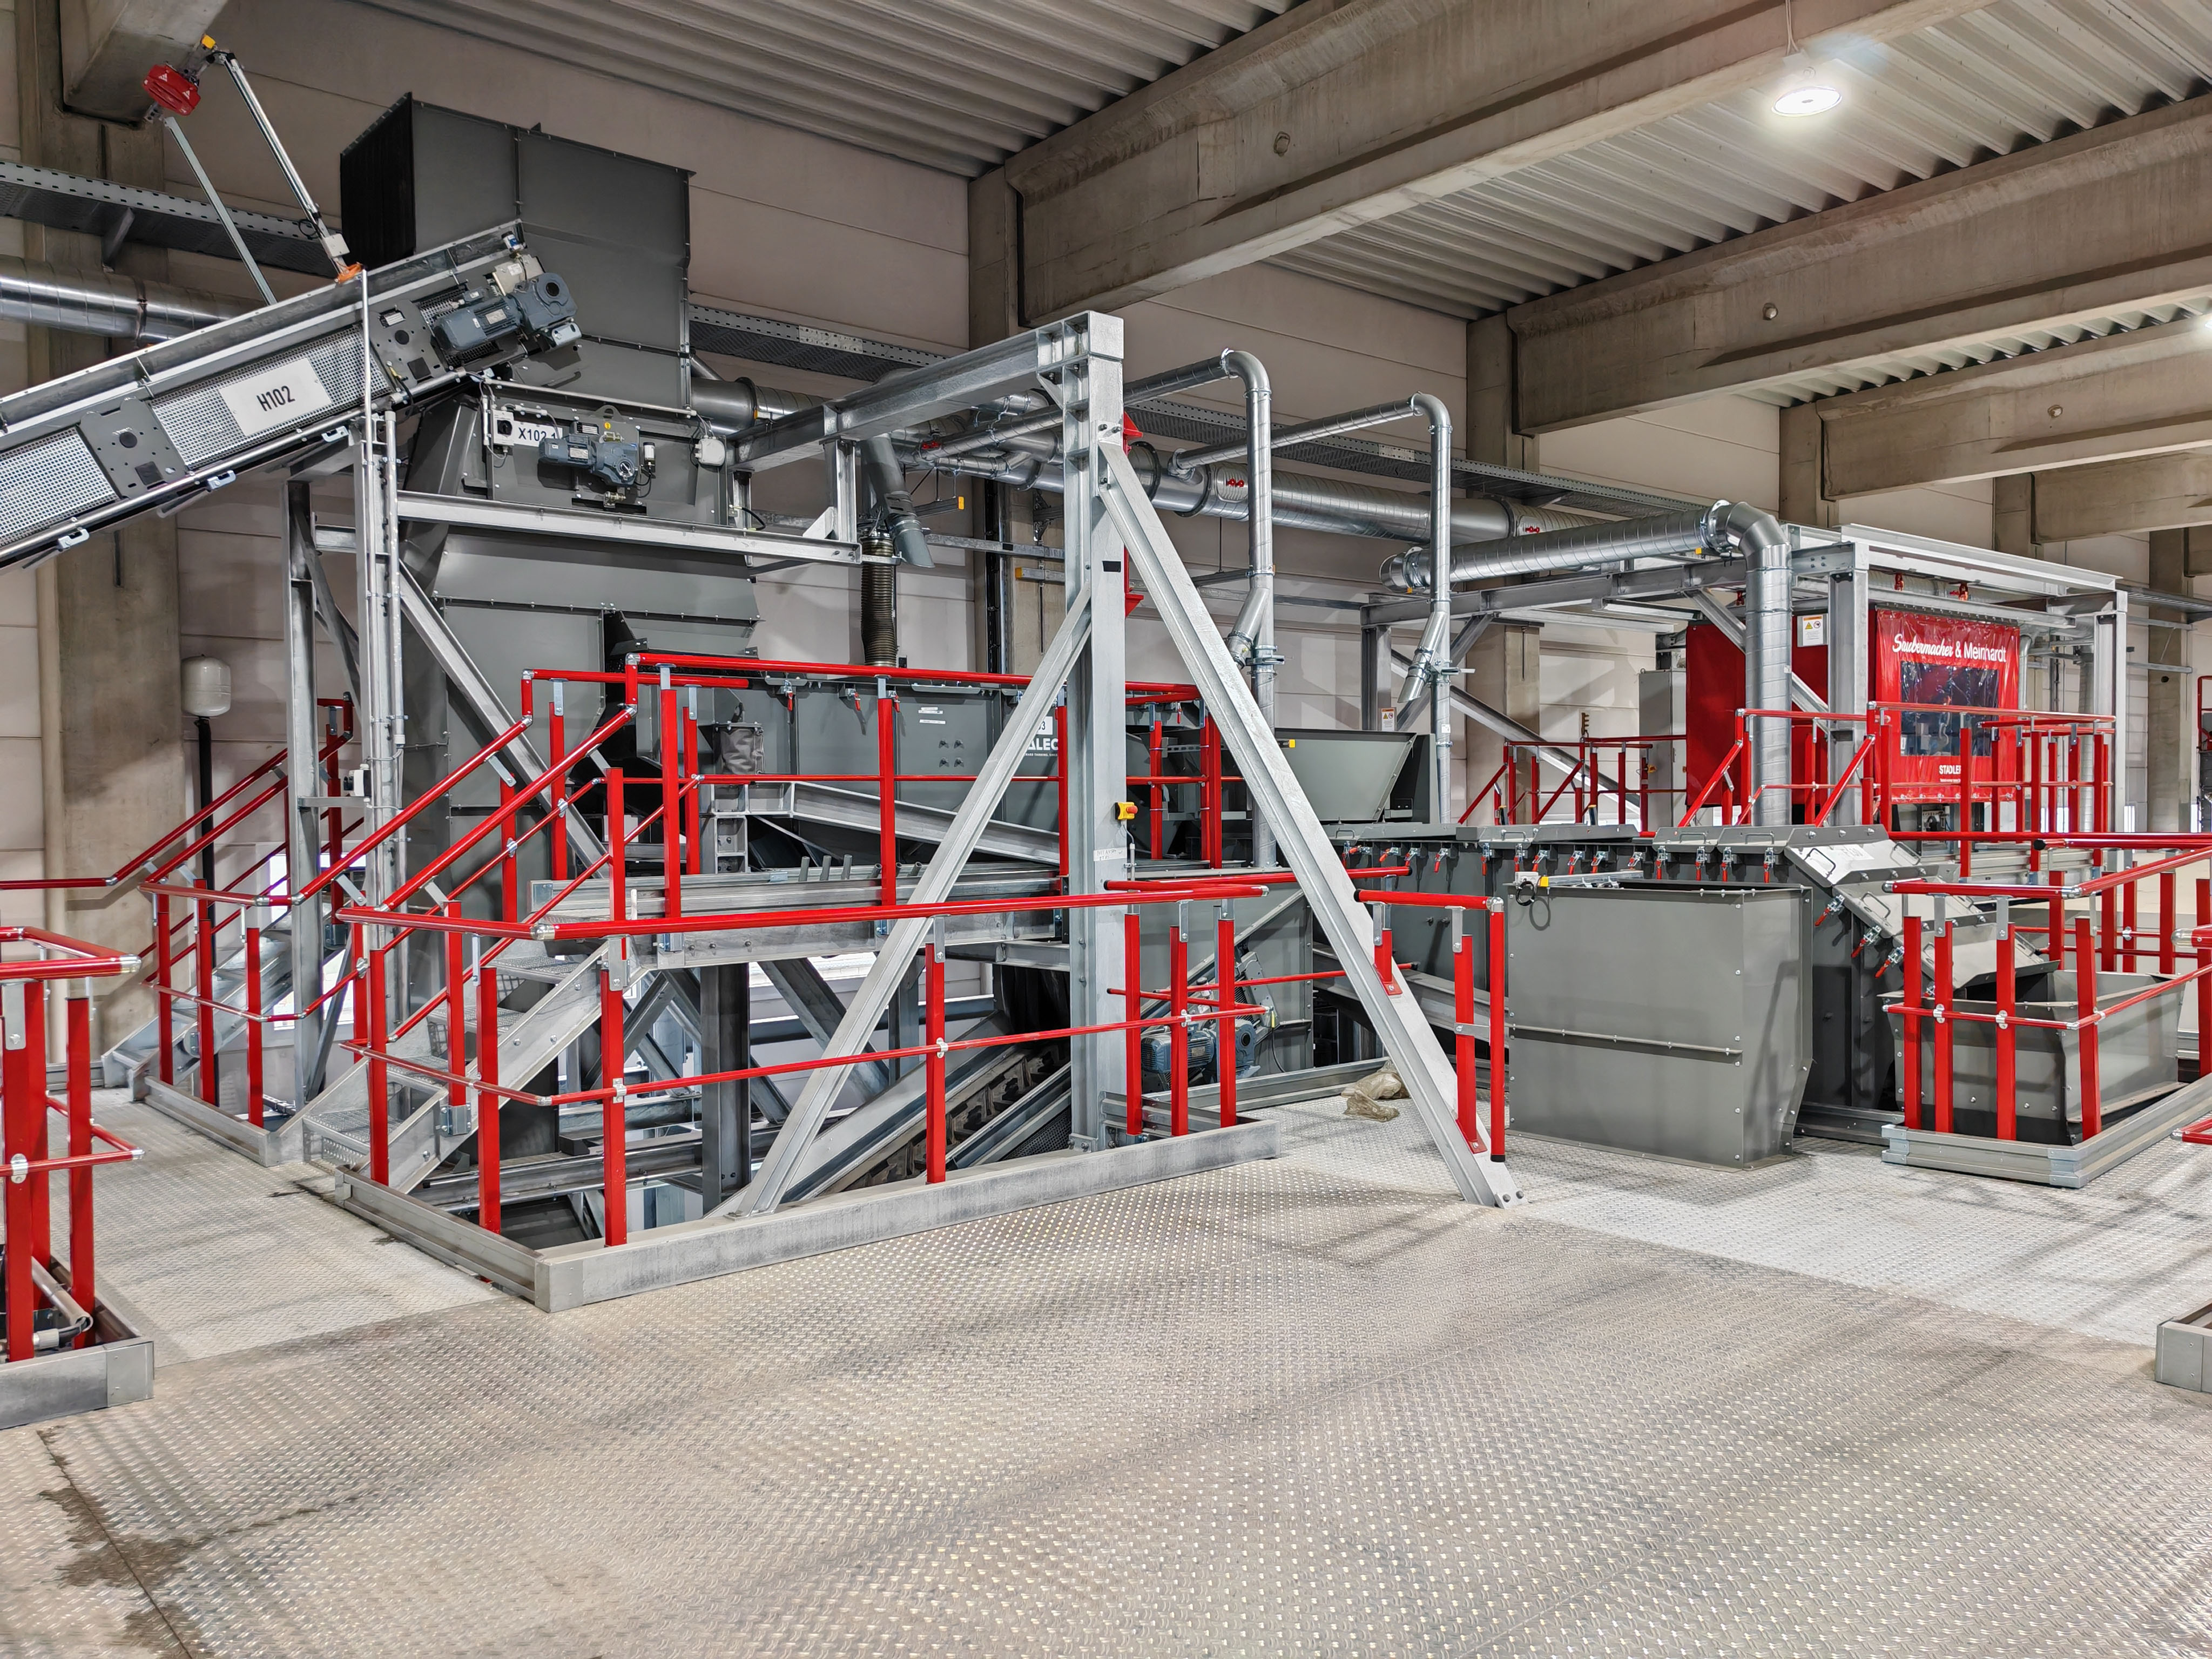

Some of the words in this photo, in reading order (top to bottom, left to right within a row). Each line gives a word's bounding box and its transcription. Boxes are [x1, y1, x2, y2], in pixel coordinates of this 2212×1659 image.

[257, 385, 296, 412] H102
[518, 427, 556, 441] X1021
[1892, 633, 1953, 658] Saubermacher
[1954, 640, 1962, 658] &
[1963, 641, 2007, 663] Meinhardt
[1027, 738, 1058, 751] ALEC
[1939, 764, 1961, 775] STADLE
